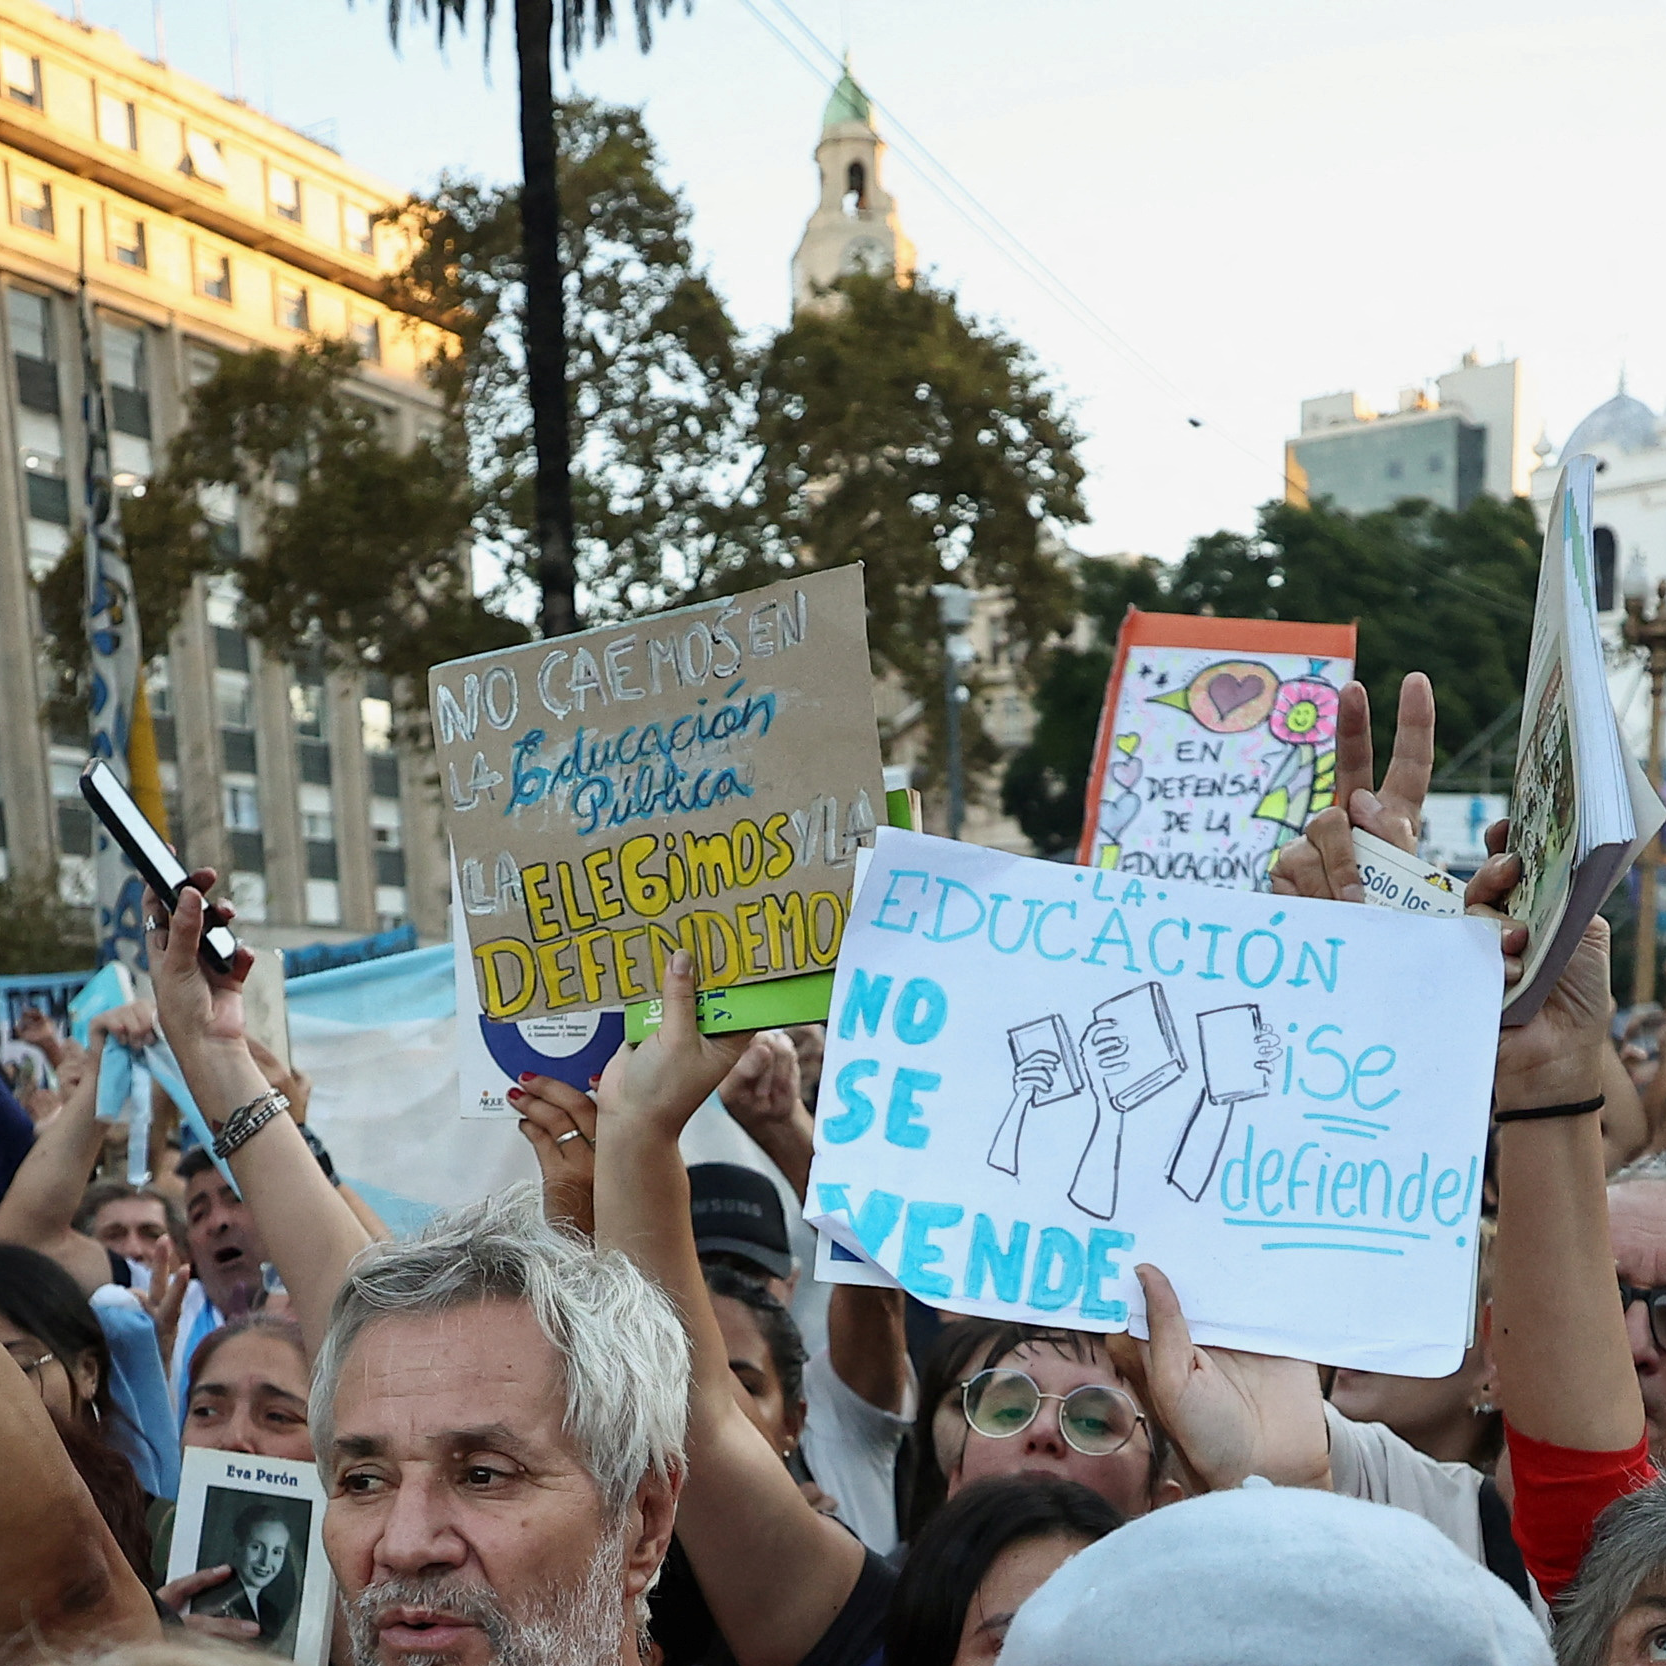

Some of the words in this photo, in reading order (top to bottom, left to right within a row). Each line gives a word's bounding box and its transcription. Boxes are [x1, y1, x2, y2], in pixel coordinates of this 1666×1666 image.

[437, 663, 521, 745] NO
[537, 606, 741, 720] CAEMOS
[749, 590, 807, 659] EN
[450, 751, 505, 812] LA
[504, 678, 778, 816] Educación
[1176, 740, 1223, 764] EN
[570, 764, 755, 837] Pública
[1146, 773, 1262, 801] DEFENSA
[1162, 810, 1191, 833] DE
[1205, 808, 1231, 837] LA
[461, 848, 525, 917] LA
[1355, 864, 1400, 900] Sólo
[475, 888, 855, 1019] DEFENDEMO
[869, 870, 1346, 994] EDUCACIÓN
[837, 967, 947, 1045] NO
[823, 1058, 942, 1150] SE
[1220, 1125, 1480, 1249] defiende!
[816, 1181, 1136, 1323] VENDE
[226, 1464, 252, 1480] Eva
[256, 1468, 298, 1487] Perón
